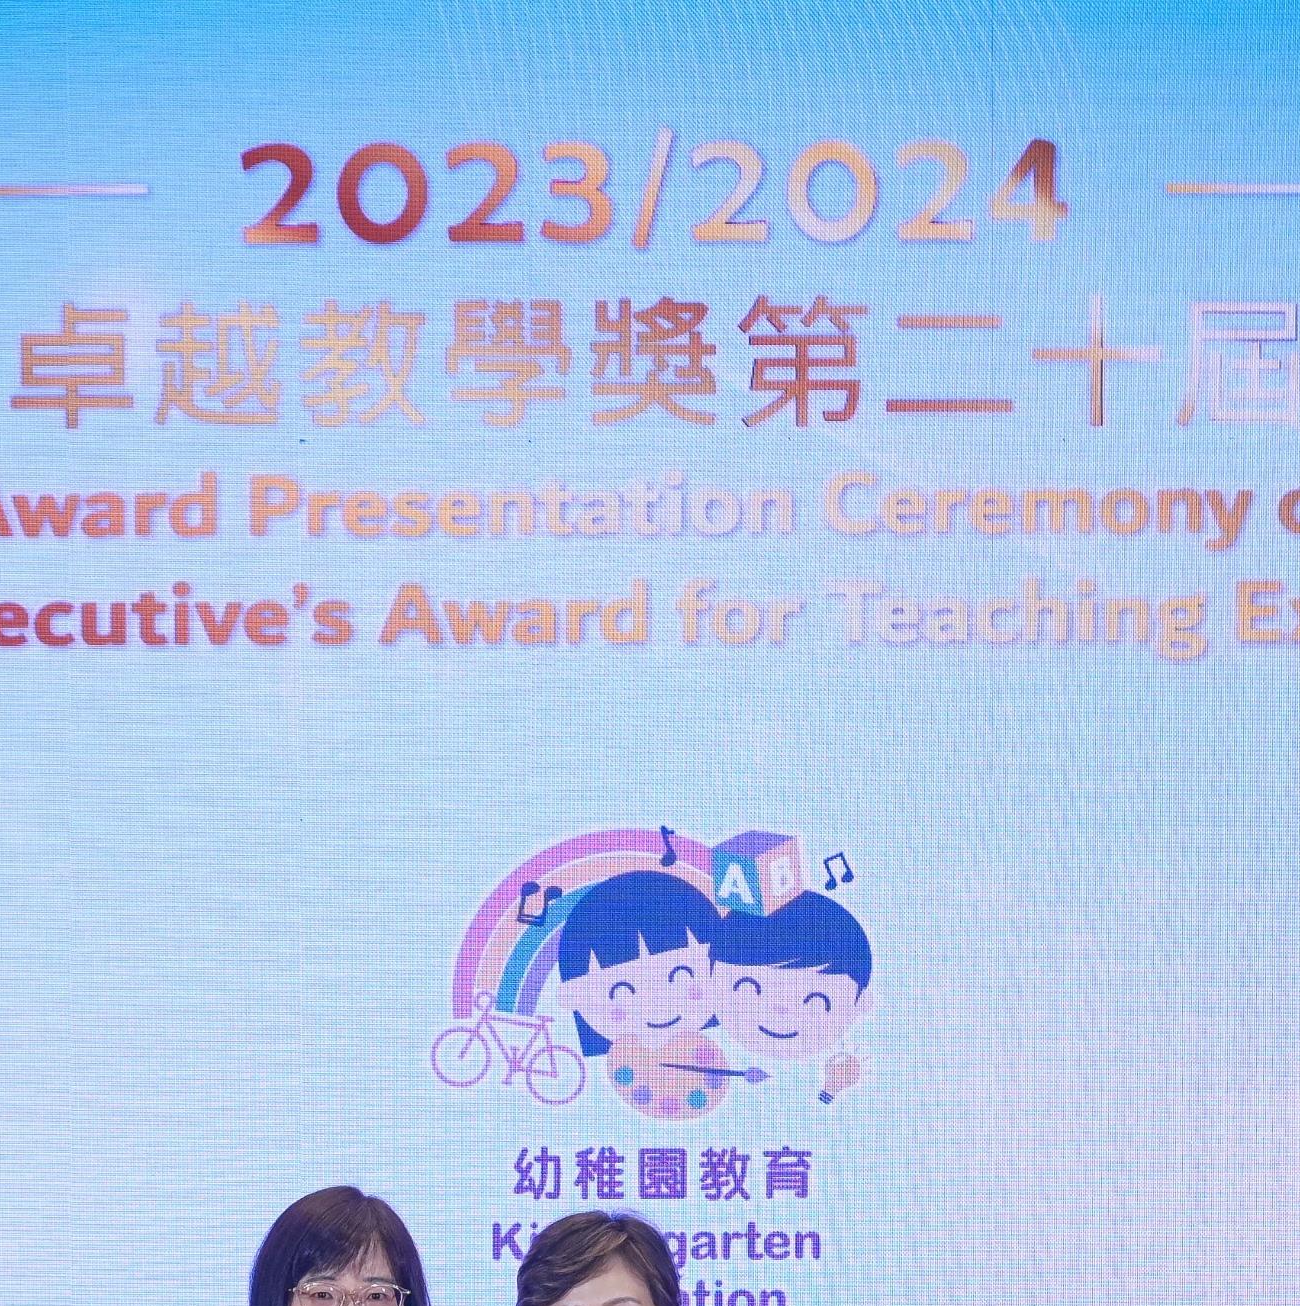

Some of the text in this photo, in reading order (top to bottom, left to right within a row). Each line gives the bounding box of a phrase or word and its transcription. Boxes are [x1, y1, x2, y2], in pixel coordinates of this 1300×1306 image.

[240, 128, 1070, 251] 2023/2024
[248, 468, 795, 539] Presentation
[822, 468, 1250, 552] Ceremony
[380, 578, 648, 649] Award
[676, 578, 804, 645] for
[827, 580, 1208, 661] Teaching
[513, 1146, 811, 1200] 幼稚園教育
